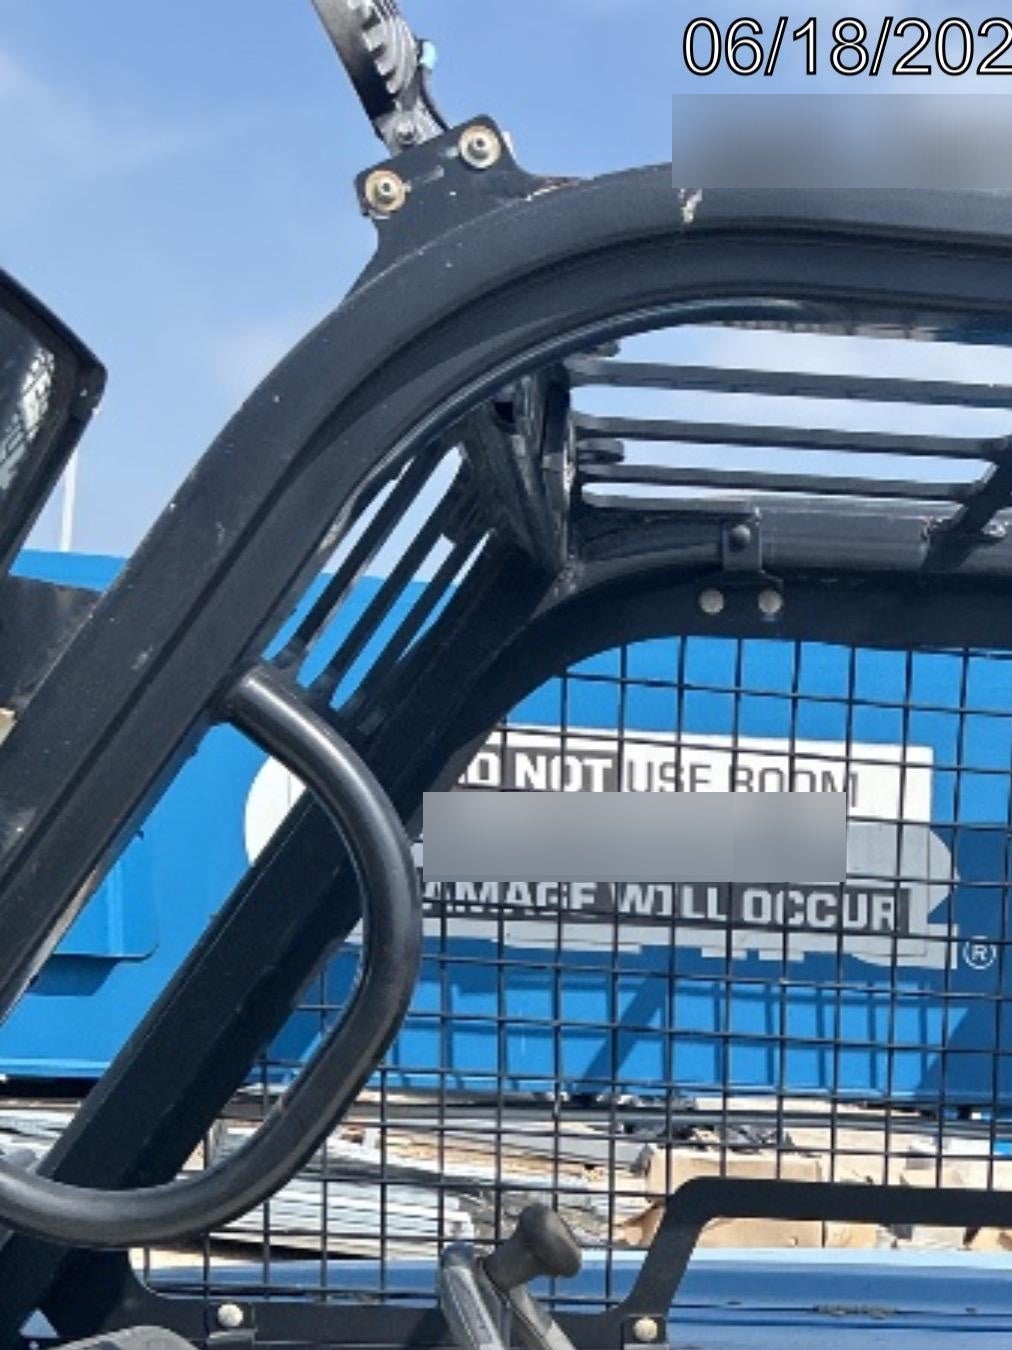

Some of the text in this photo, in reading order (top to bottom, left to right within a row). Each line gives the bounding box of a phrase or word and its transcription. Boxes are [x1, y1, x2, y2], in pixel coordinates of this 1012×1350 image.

[458, 751, 499, 787] O
[514, 752, 613, 791] NOT
[422, 881, 896, 930] AMAGE WILL OCCUR
